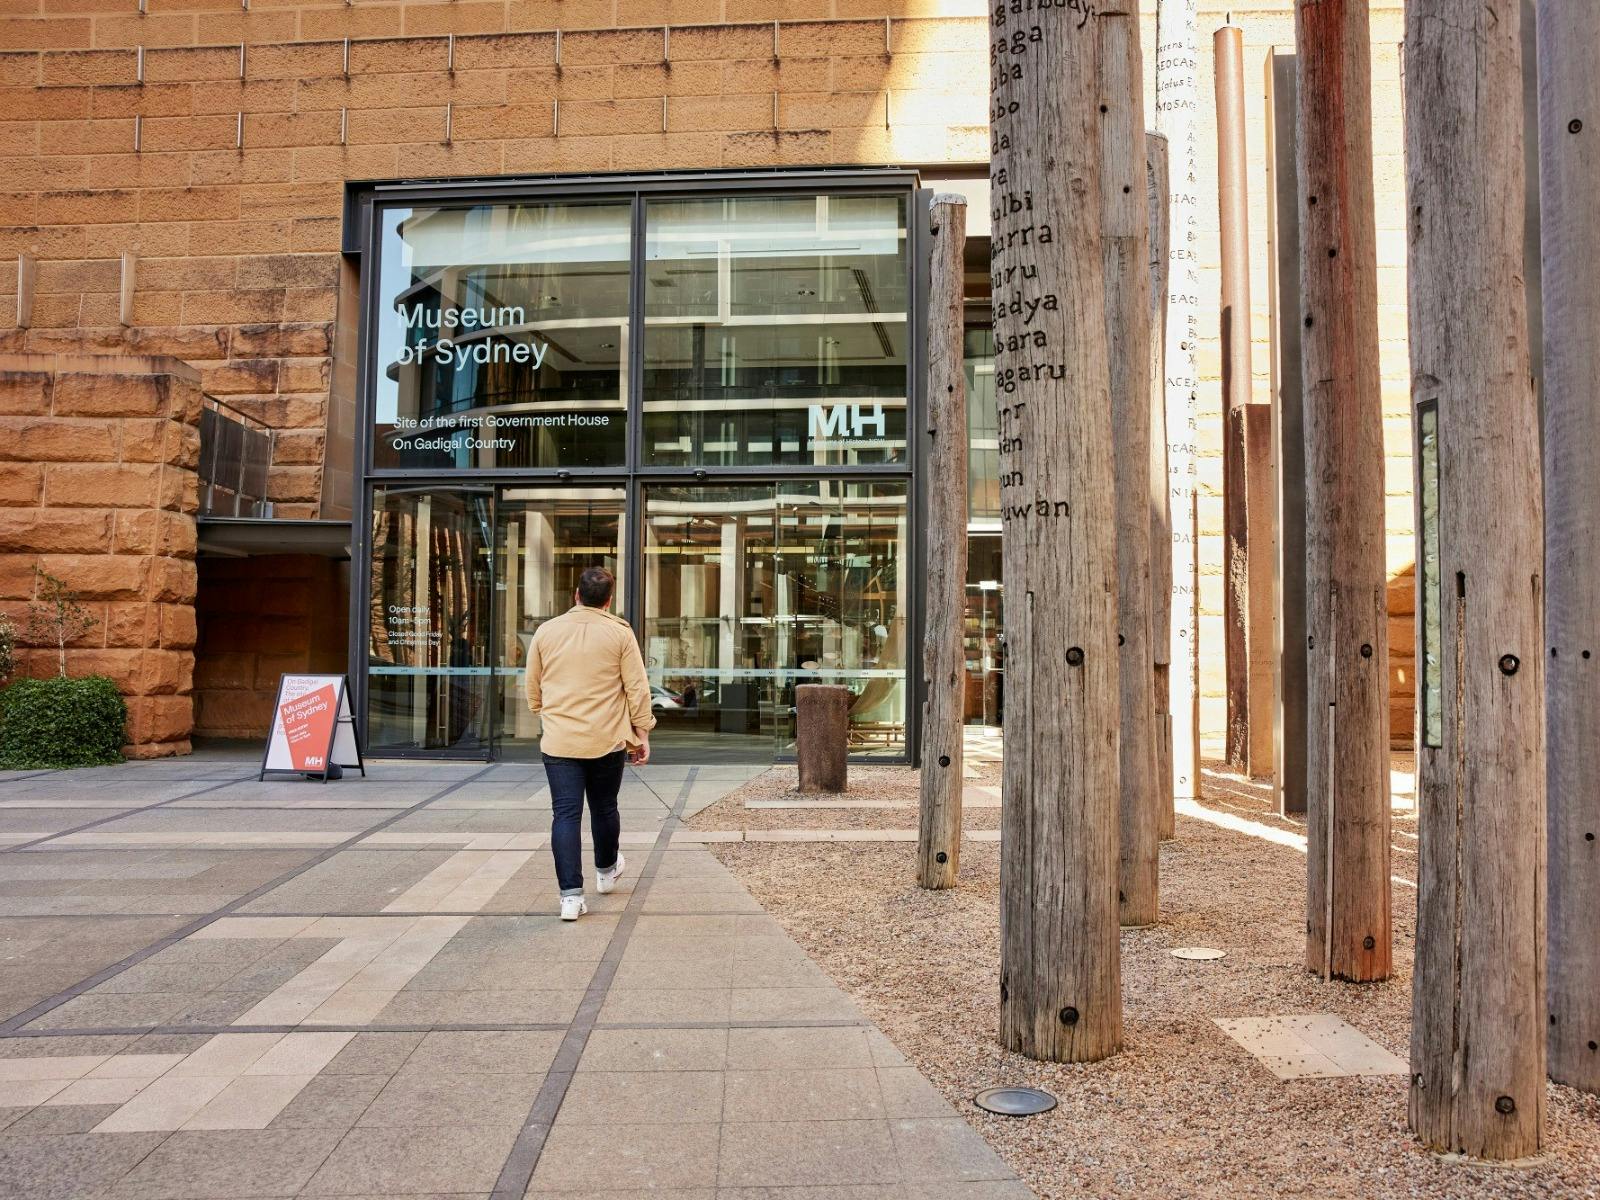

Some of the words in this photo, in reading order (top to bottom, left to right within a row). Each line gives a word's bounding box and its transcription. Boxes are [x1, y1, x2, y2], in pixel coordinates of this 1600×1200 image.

[397, 303, 525, 329] Museum
[397, 338, 427, 365] of
[435, 337, 548, 371] Sydney
[393, 417, 418, 428] Site
[420, 416, 435, 428] of
[436, 416, 456, 428] the
[458, 416, 483, 428] first
[486, 415, 565, 428] Government
[568, 414, 609, 427] House
[808, 404, 885, 436] MH
[393, 438, 411, 451] On
[414, 437, 462, 452] Gadigal
[465, 437, 516, 452] Country
[389, 605, 411, 614] Open
[412, 605, 430, 614] daily
[284, 695, 320, 715] Museum
[286, 713, 295, 724] of
[296, 702, 328, 720] Sydney
[305, 756, 323, 766] MH
